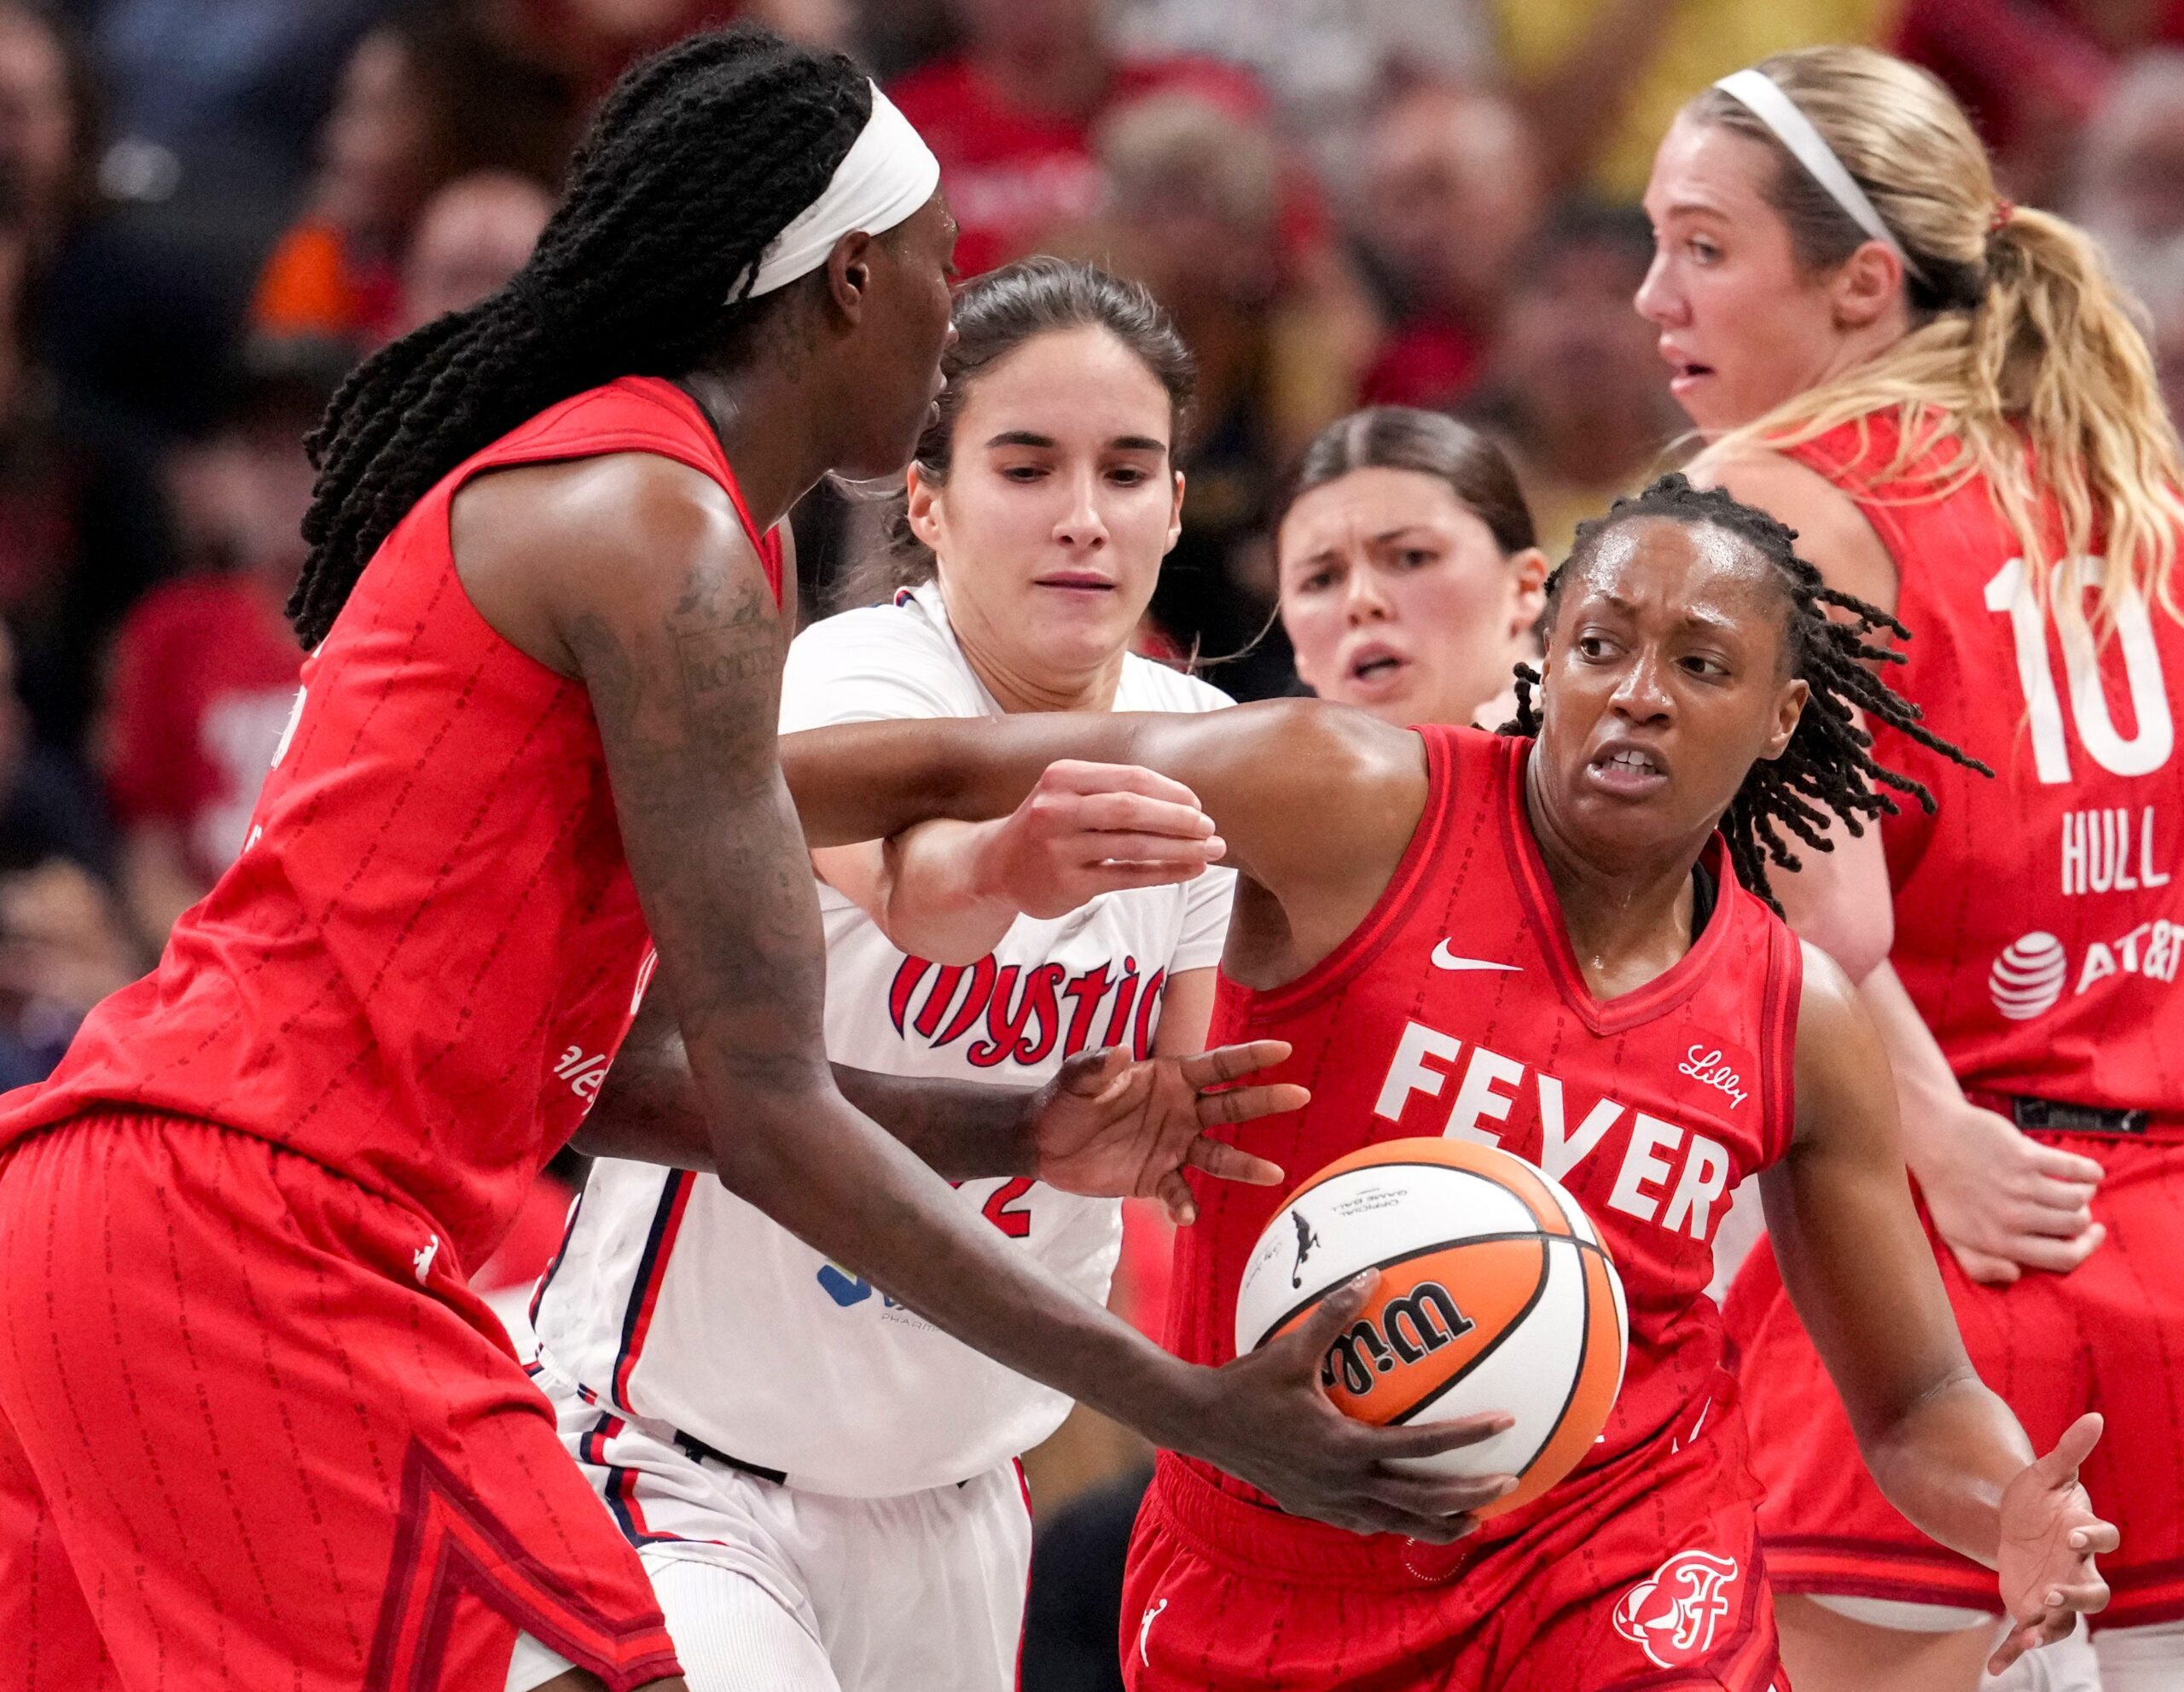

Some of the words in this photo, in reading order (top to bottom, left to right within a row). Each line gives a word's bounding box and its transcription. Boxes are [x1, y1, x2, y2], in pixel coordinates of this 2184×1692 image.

[1984, 555, 2175, 784] 10
[2061, 805, 2171, 896] HULL
[2075, 918, 2184, 996] AT&T
[889, 953, 1167, 1067] Mystic
[1677, 1044, 1748, 1110] Lilly
[1373, 1019, 1730, 1241] FEVER
[881, 1312, 936, 1332] PHARM
[1321, 1281, 1478, 1397] Wil
